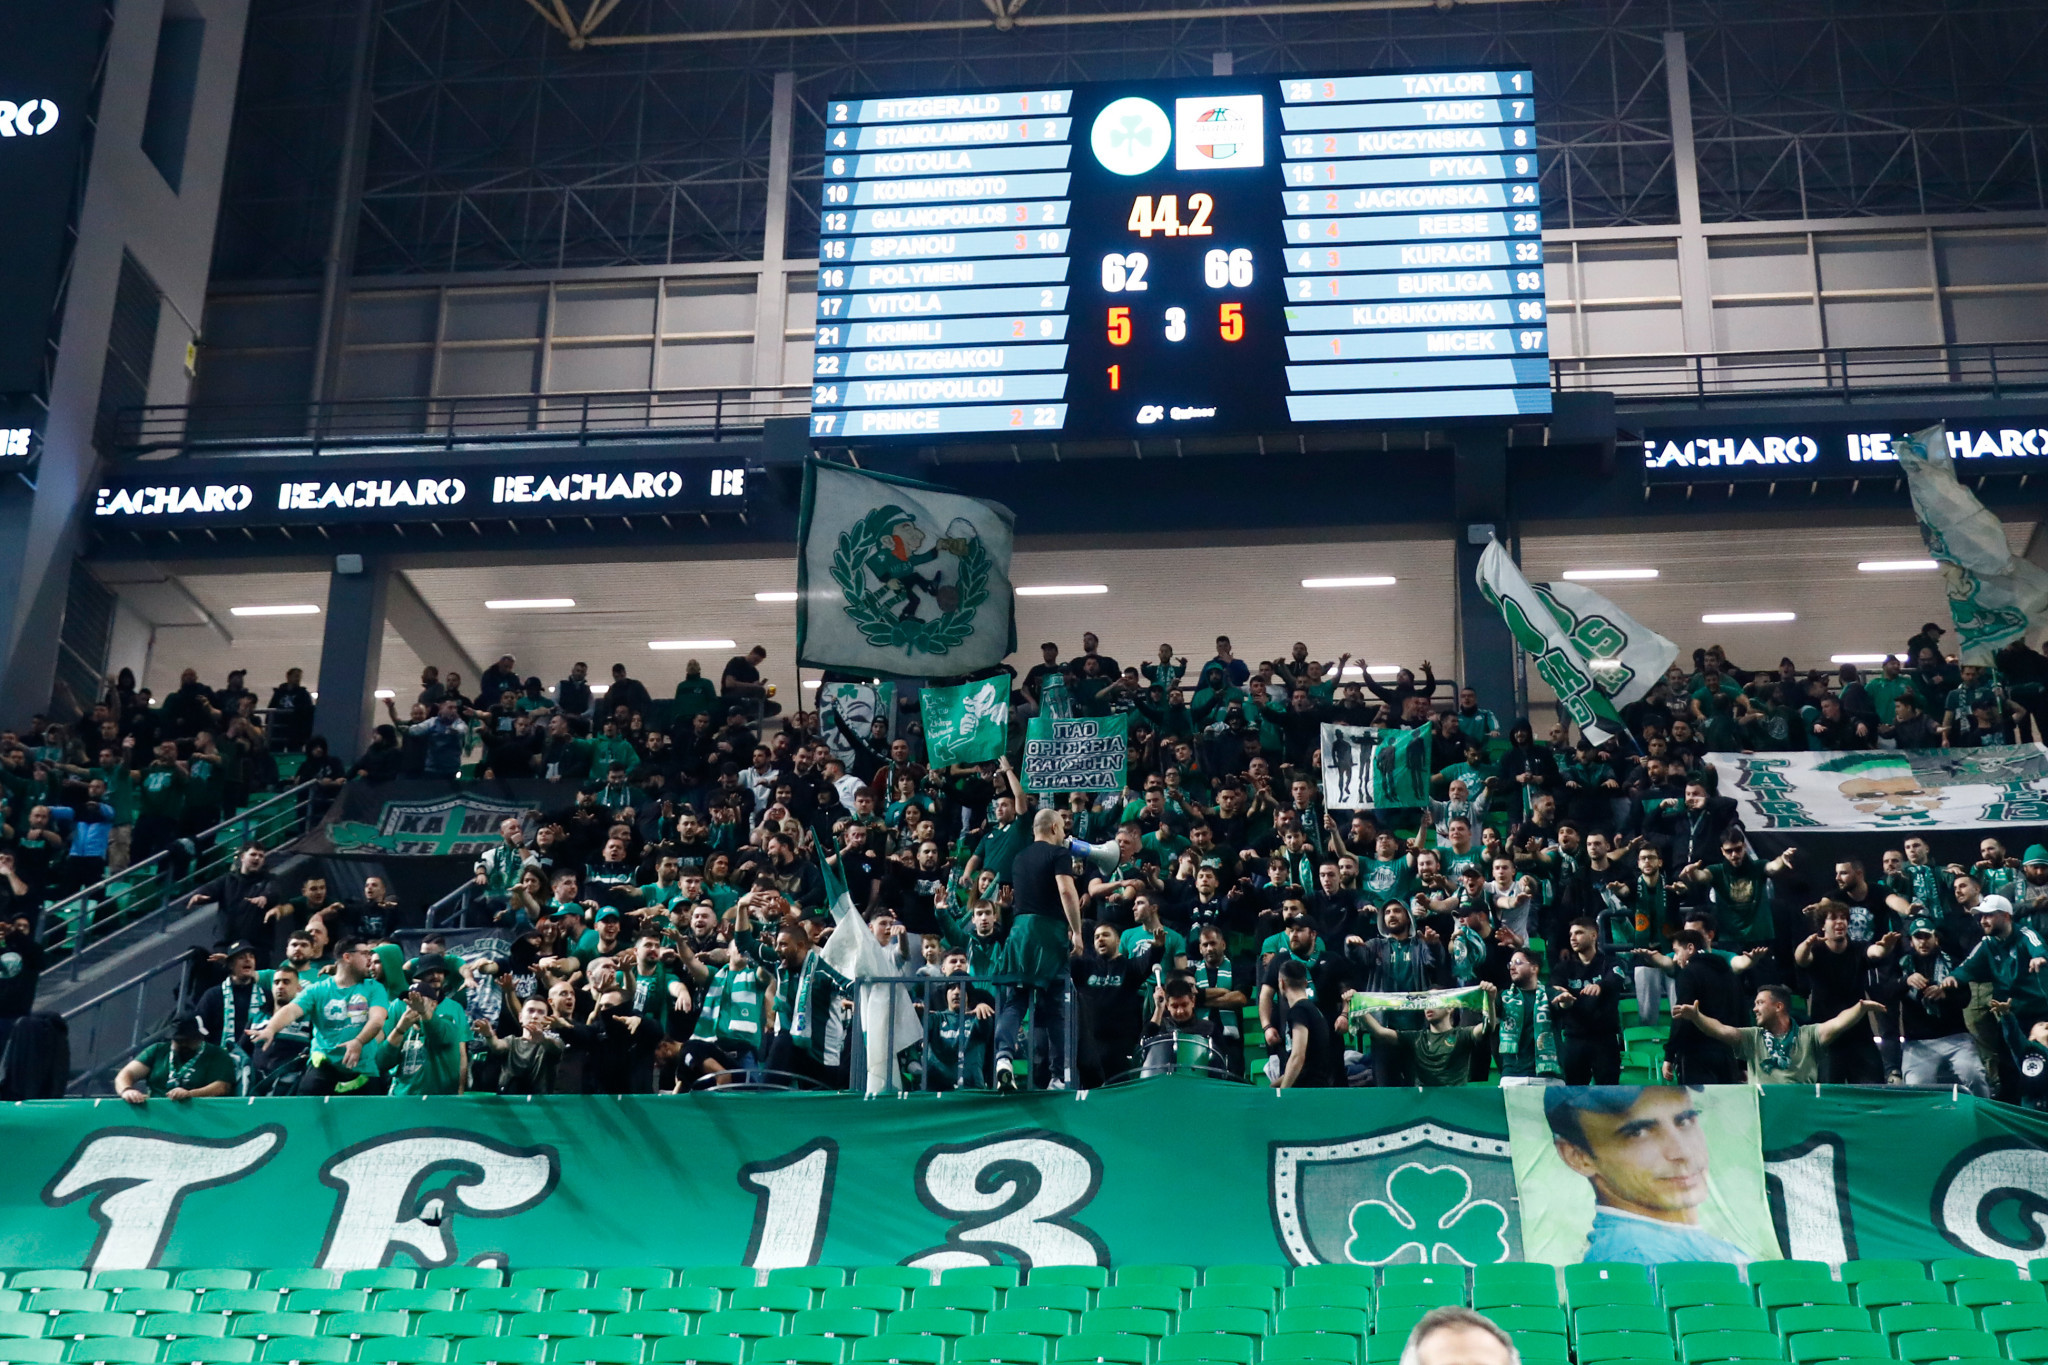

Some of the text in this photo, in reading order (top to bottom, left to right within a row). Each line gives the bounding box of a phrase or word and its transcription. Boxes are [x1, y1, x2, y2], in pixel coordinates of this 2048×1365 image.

[1324, 82, 1335, 97] 3
[1403, 75, 1485, 94] TAYLOR
[1512, 75, 1521, 90] 1
[835, 95, 1061, 120] 2 FITZGERALD 1 15
[1422, 102, 1524, 121] TADIC 7
[833, 121, 1056, 147] 4 STAMOLAMPROU 1 2
[1292, 129, 1527, 155] 12 2 KUCZYNSKA 8
[832, 152, 972, 175] 6 KOTOULA
[1292, 157, 1528, 182] 15 1 PYKA 9
[827, 178, 1007, 202] 10 KOUMANTSIOTO
[1297, 186, 1535, 211] 2 2 JACKOWSKA 24
[825, 213, 846, 230] 12
[1015, 206, 1027, 222] 3
[1043, 205, 1054, 221] 2
[1128, 193, 1213, 237] 44.2
[1327, 222, 1339, 237] 4
[1419, 215, 1488, 234] REESE
[1514, 214, 1537, 232] 25
[824, 233, 1059, 258] 15 SPANOU 3 10
[1298, 243, 1538, 268] 4 3 KURACH 32
[822, 264, 973, 287] 16 POLYMENI
[1102, 248, 1253, 292] 62 66
[1299, 272, 1540, 298] 2 1 BURLIGA 93
[821, 290, 1053, 316] 17 VITOLA 2
[1353, 302, 1541, 325] KLOBUKOWSKA 96
[818, 327, 838, 345] 21
[866, 323, 942, 342] KRIMILI
[1013, 320, 1025, 336] 2
[1108, 303, 1245, 346] 5 3 5
[1330, 331, 1543, 355] 1 MICEK 97
[817, 349, 1003, 374] 22 CHATZIGIAKOU
[1107, 364, 1120, 390] 1
[815, 379, 1003, 404] 24 YFANTOPOULOU
[814, 408, 1056, 433] 77 PRINCE 2 22
[279, 478, 465, 510] BEACHARO
[493, 471, 682, 503] BEACHARO
